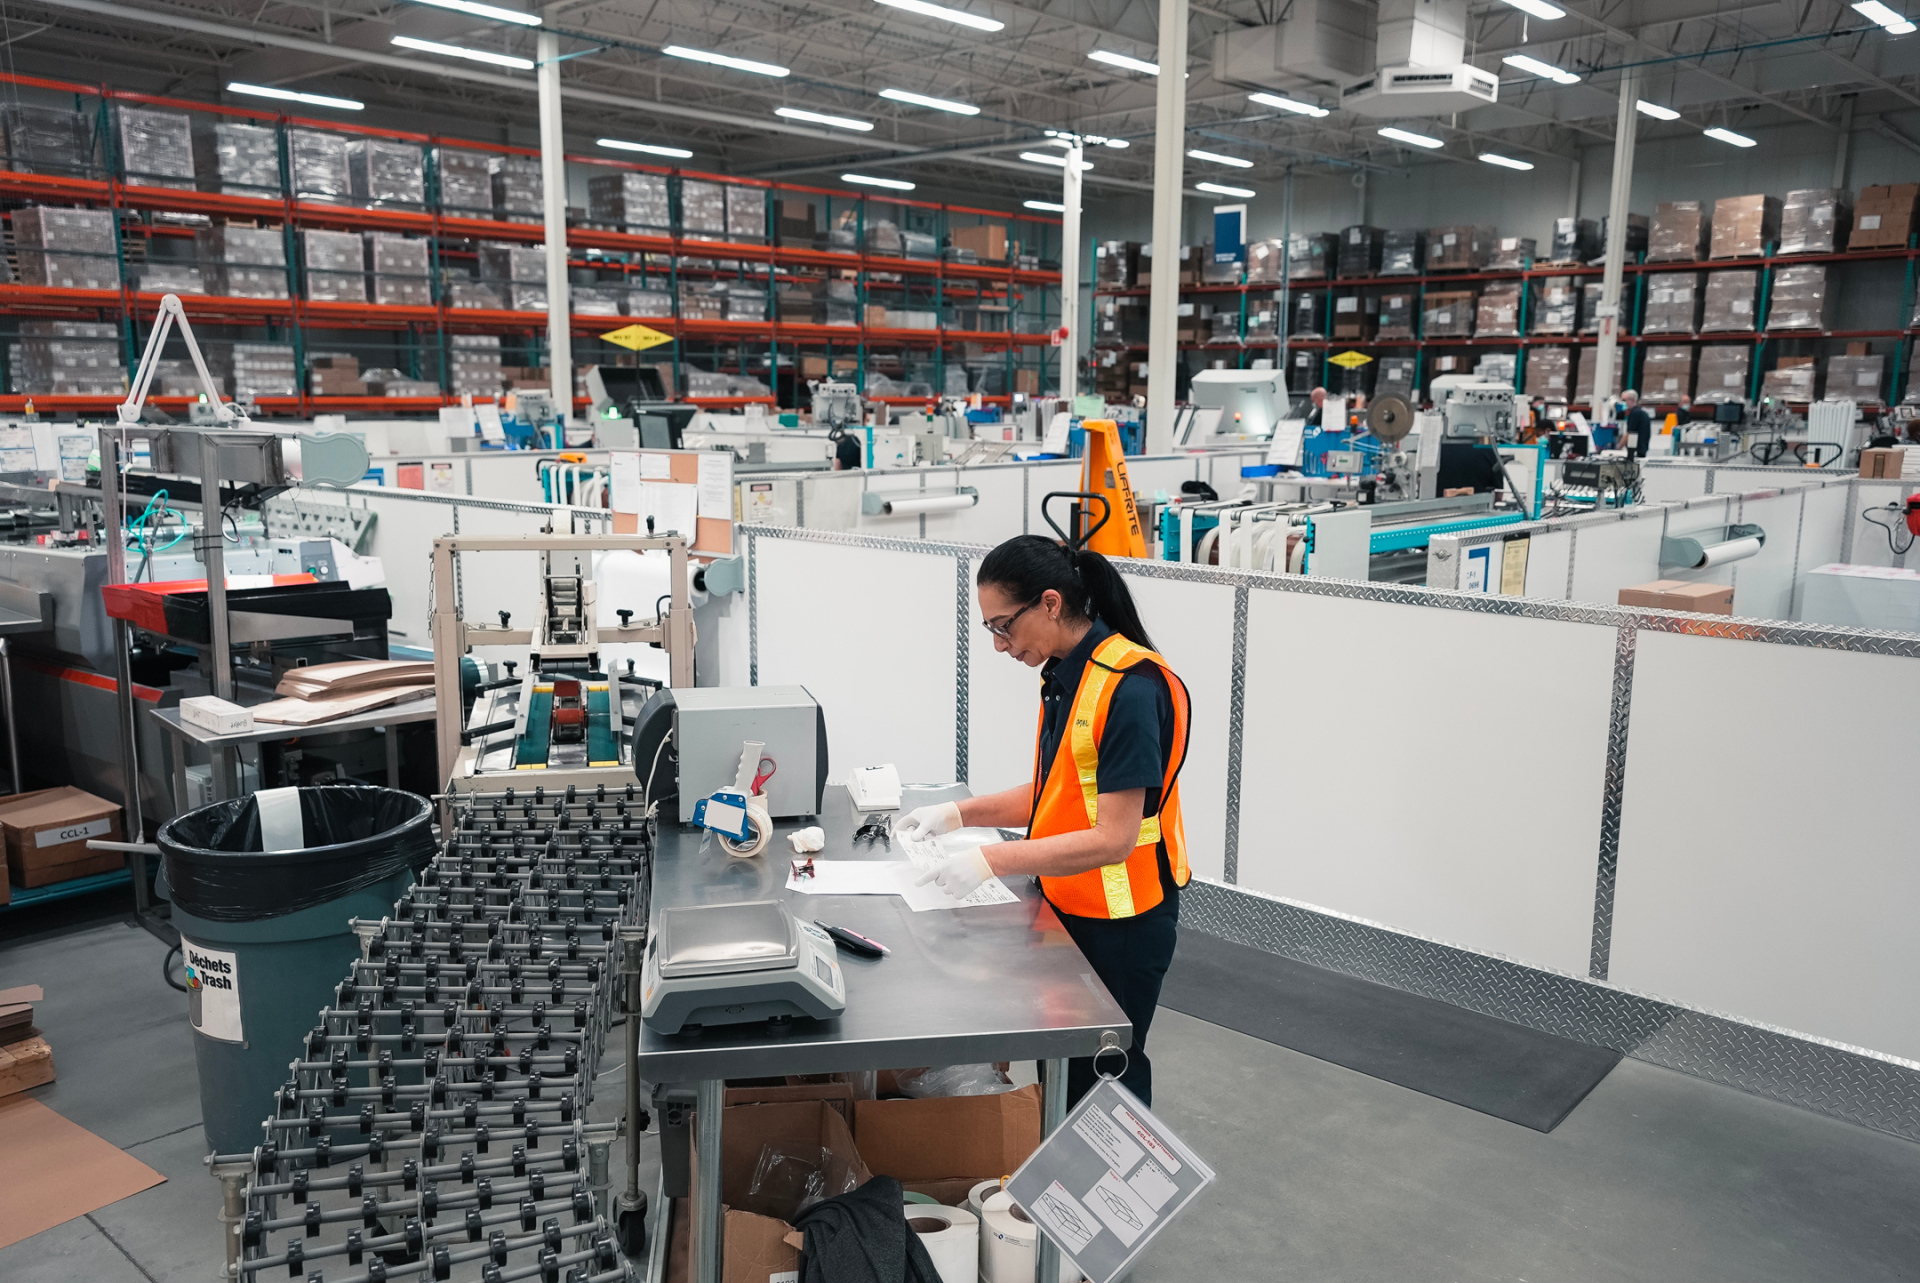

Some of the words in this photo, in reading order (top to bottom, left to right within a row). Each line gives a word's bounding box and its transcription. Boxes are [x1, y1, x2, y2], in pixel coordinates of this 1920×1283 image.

[60, 826, 90, 840] CCL-1
[189, 949, 232, 974] Déchets
[200, 970, 232, 990] Trash
